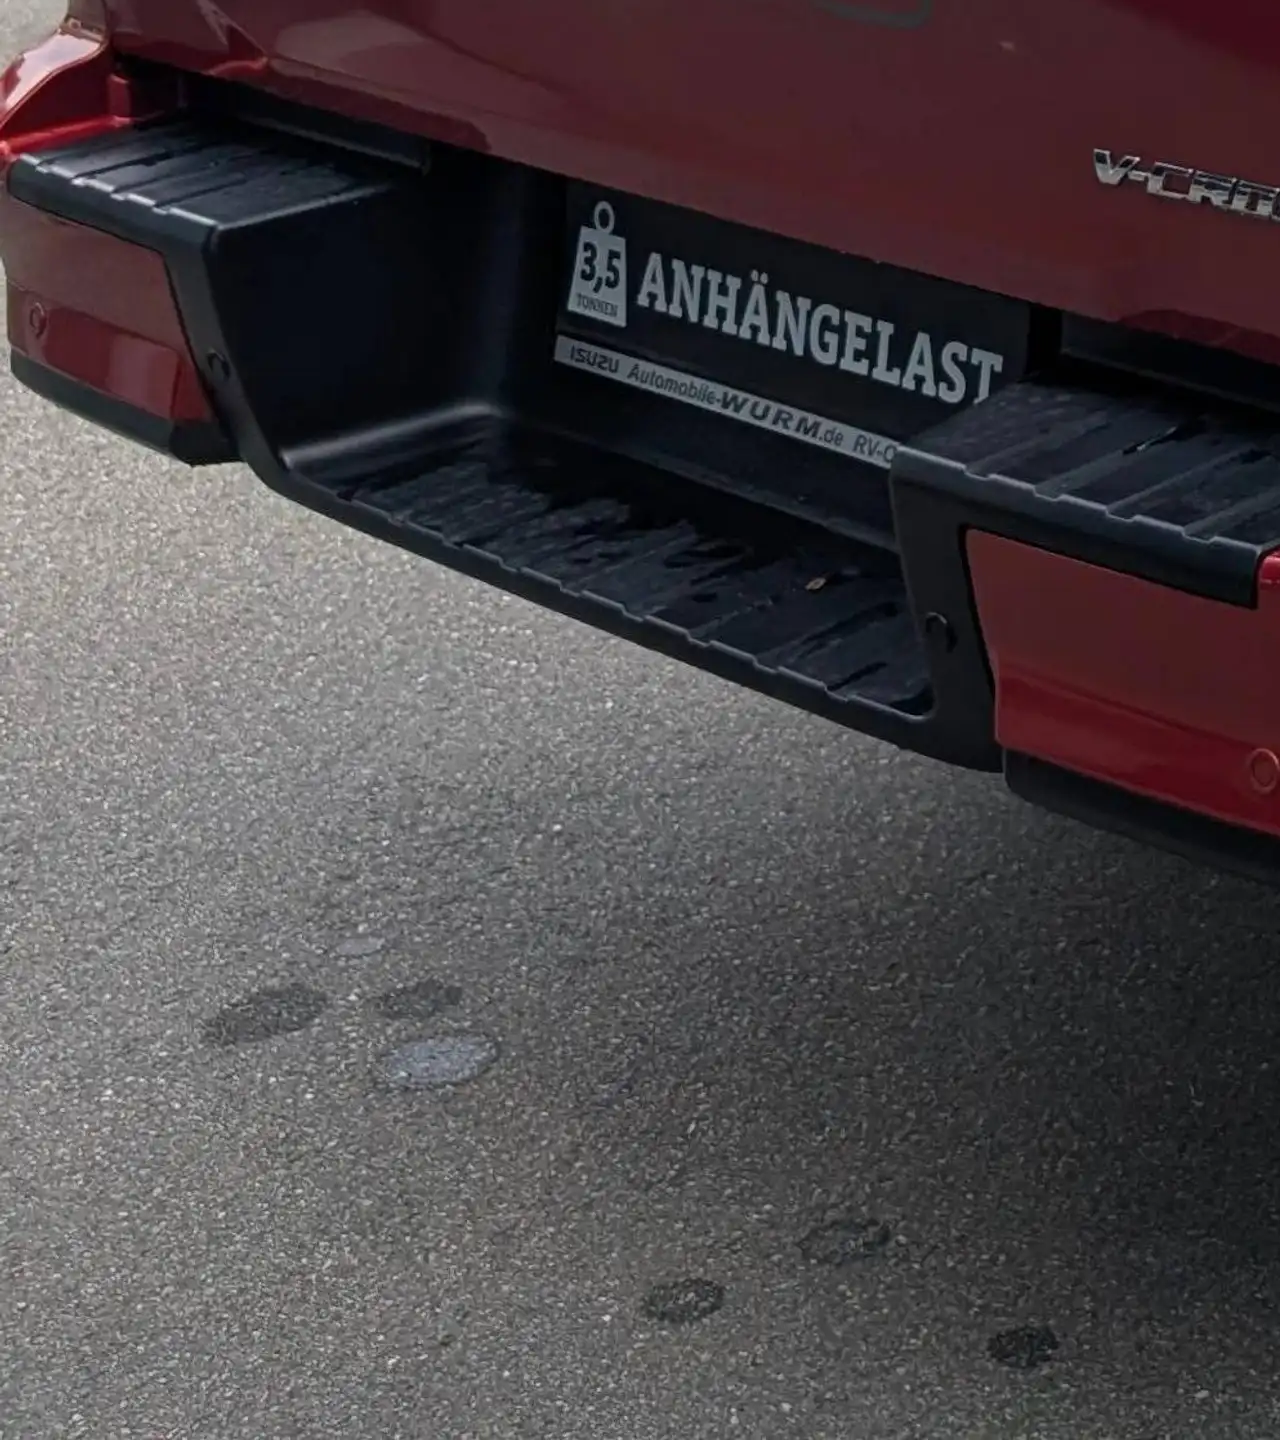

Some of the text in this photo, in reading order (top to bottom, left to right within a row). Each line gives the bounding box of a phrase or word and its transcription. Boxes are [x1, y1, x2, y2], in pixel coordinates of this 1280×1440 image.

[579, 241, 622, 294] 3,5
[636, 251, 1003, 406] ANHÄNGELAST
[569, 345, 620, 374] ISUZU
